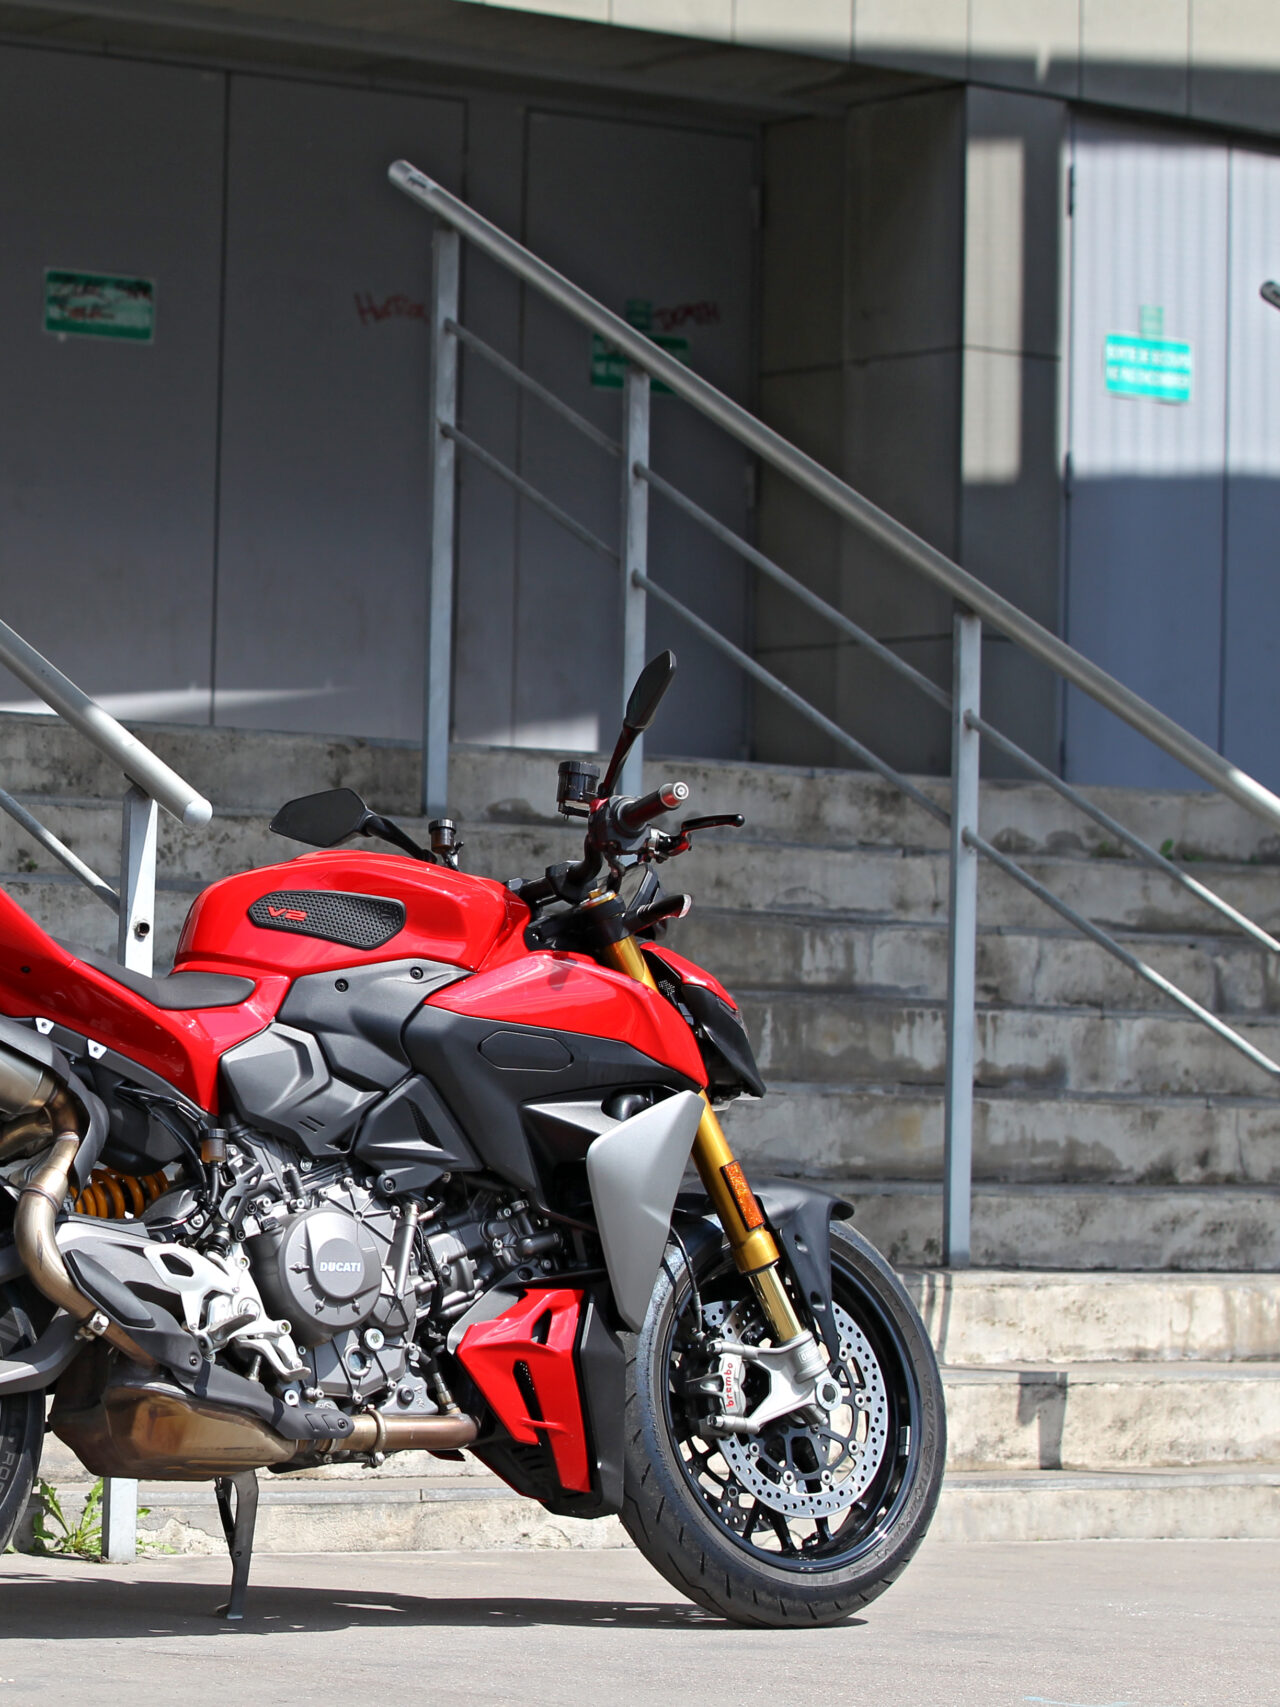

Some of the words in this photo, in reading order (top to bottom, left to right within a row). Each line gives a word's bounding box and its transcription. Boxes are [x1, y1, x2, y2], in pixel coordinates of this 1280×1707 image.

[267, 905, 308, 922] V2
[319, 1261, 361, 1272] DUCATI
[723, 1362, 735, 1408] brembo
